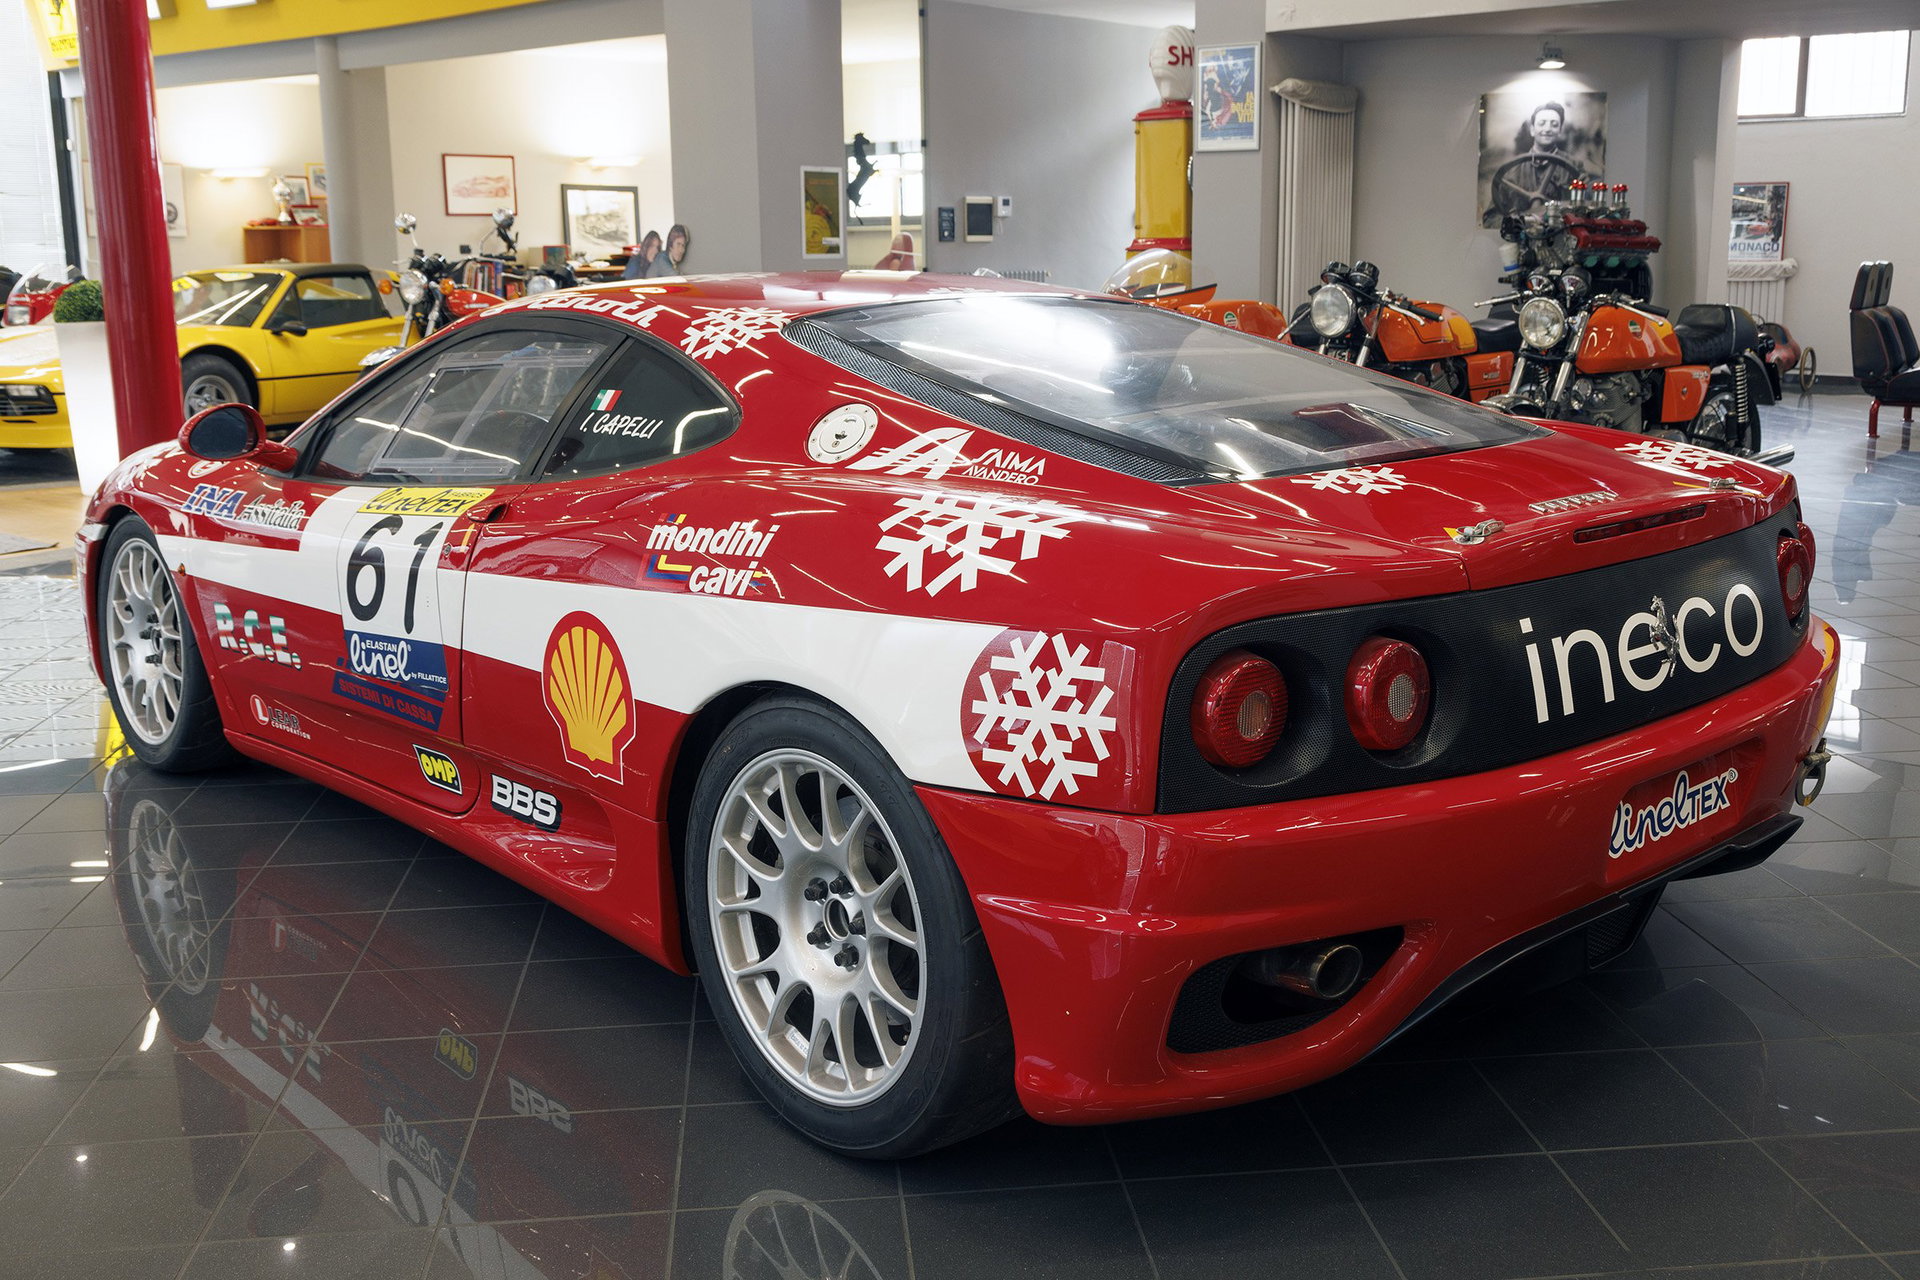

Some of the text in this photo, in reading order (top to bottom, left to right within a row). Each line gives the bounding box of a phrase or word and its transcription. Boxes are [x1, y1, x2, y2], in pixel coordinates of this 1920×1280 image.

[593, 413, 664, 439] CAPELLI
[962, 465, 1039, 485] AVANDERO
[181, 483, 247, 519] INA
[646, 519, 780, 558] mondini
[347, 514, 443, 635] 61
[688, 561, 759, 597] cavi
[350, 633, 411, 682] linel
[417, 672, 447, 684] FILLATTICE
[366, 640, 398, 653] ELASTAN
[1519, 583, 1764, 724] ineco
[268, 706, 300, 731] LEAR
[338, 679, 436, 725] SISTEMI DI CASSA
[271, 721, 311, 740] CORPORATION
[420, 753, 456, 784] OMP
[491, 774, 558, 827] BBS
